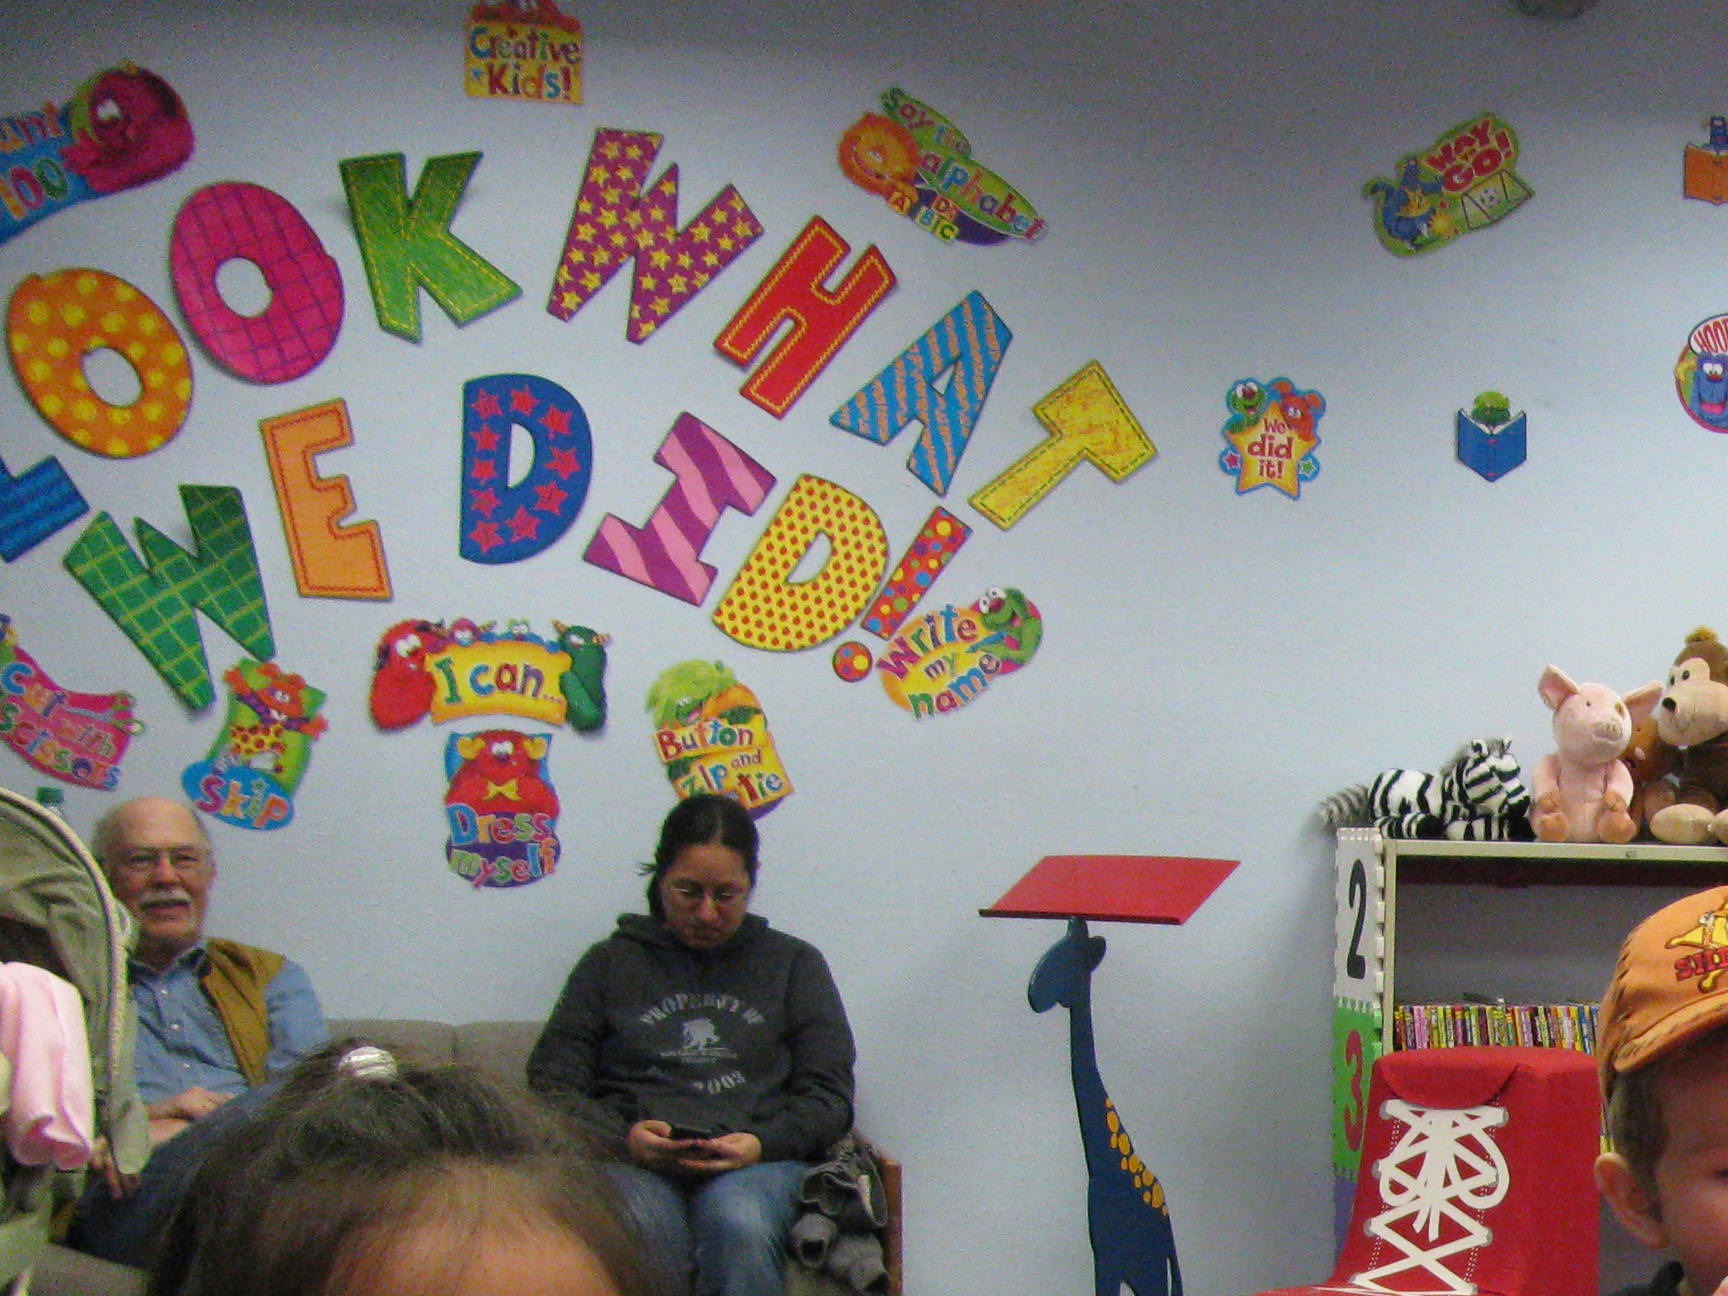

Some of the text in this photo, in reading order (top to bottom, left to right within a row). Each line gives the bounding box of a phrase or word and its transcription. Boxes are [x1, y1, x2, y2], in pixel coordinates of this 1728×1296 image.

[469, 26, 580, 64] Creative
[487, 62, 572, 100] Kids!
[1427, 119, 1492, 171] WAY
[1443, 131, 1512, 192] GO!
[920, 152, 1045, 240] alphabet
[546, 127, 1156, 529] WHAT
[1248, 433, 1293, 459] did
[1263, 417, 1286, 434] We
[1259, 458, 1283, 479] it!
[62, 373, 972, 712] WE DID!
[876, 604, 978, 679] Write
[924, 651, 957, 680] my
[434, 656, 463, 704] I
[908, 654, 1000, 721] name
[658, 719, 754, 760] Button
[731, 748, 762, 768] and
[195, 775, 289, 829] Skip
[737, 771, 784, 801] tie
[446, 803, 551, 845] Dress
[450, 838, 556, 889] myself
[1346, 859, 1367, 980] 2
